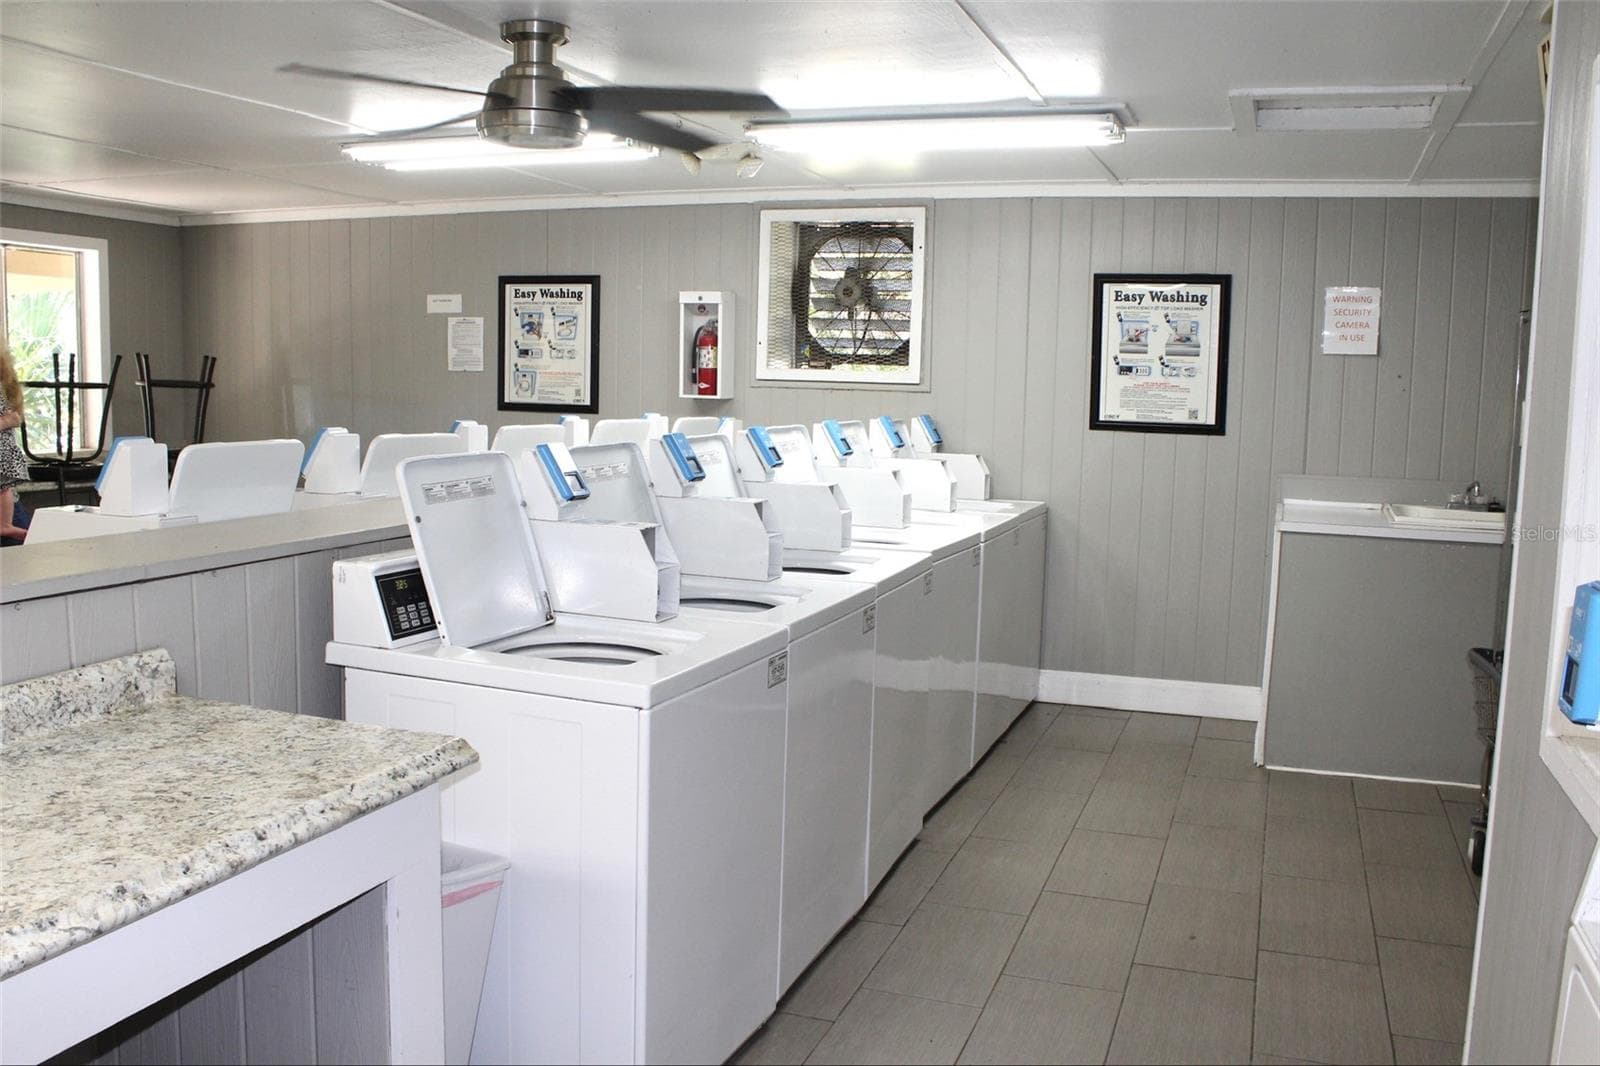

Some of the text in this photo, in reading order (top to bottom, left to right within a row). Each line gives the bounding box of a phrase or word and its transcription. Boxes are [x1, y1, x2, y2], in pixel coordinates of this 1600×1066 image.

[513, 288, 583, 301] Easy Washing
[1114, 290, 1208, 306] Easy Washing
[1332, 296, 1373, 304] WARNING
[1333, 309, 1371, 317] SECURITY
[1335, 321, 1370, 329] CAMERA
[1350, 334, 1366, 342] USE
